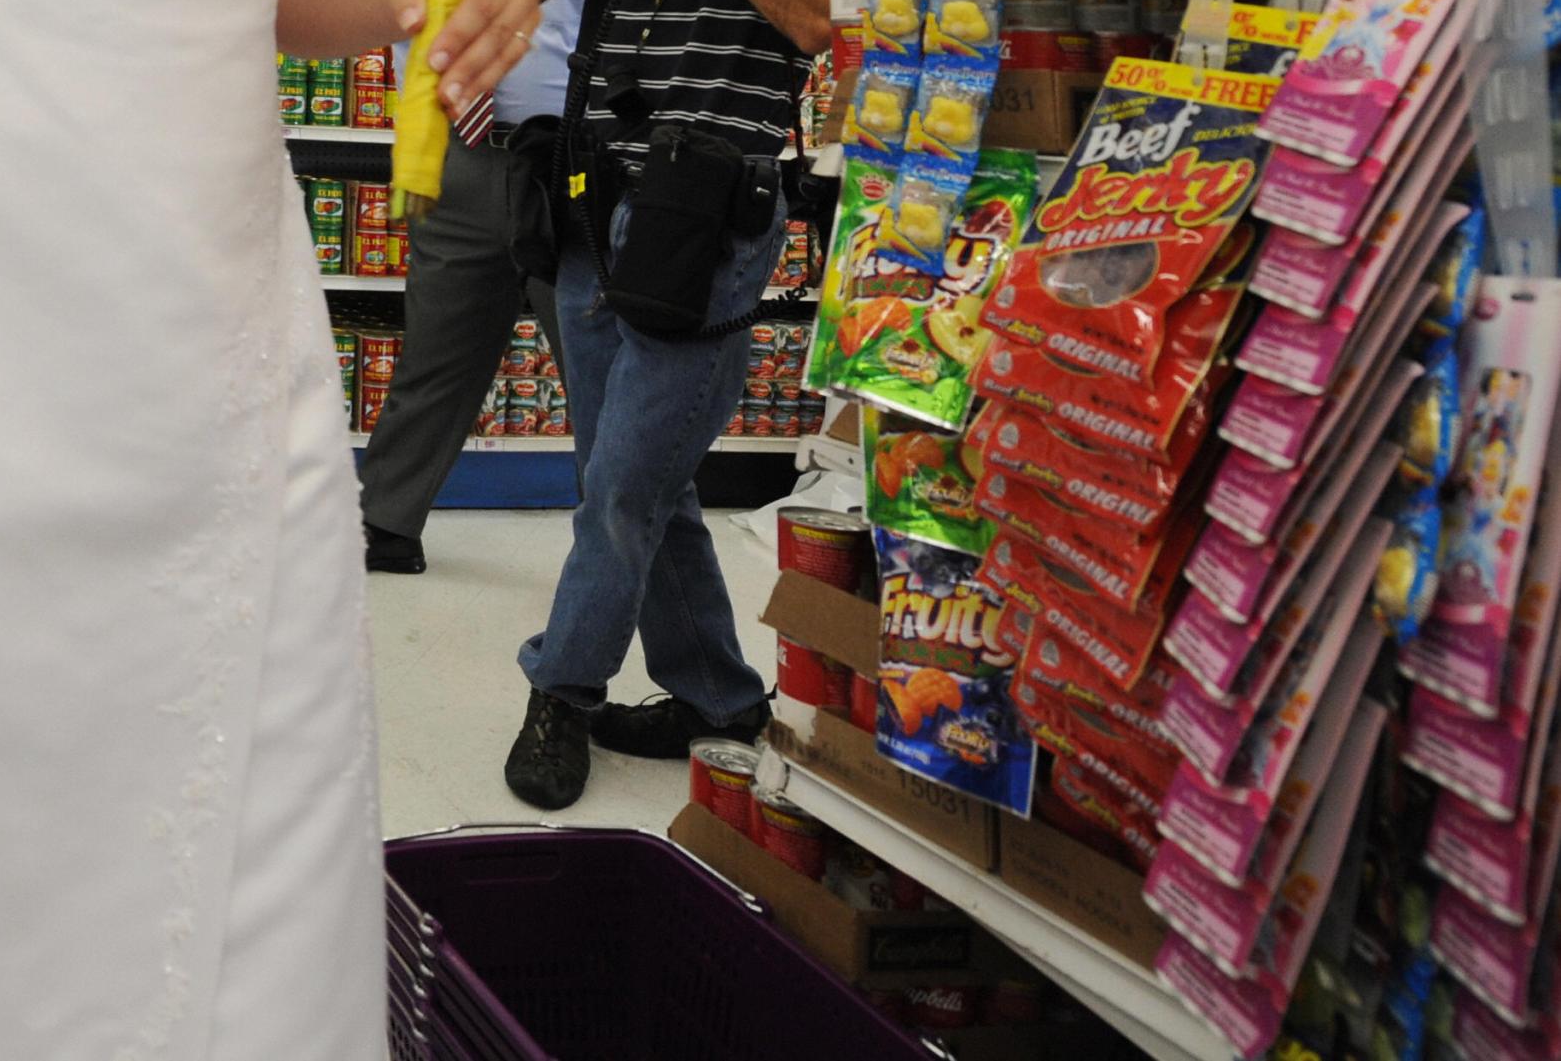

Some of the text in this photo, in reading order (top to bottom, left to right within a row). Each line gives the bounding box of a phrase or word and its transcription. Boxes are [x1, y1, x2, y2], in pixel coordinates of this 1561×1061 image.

[994, 86, 1035, 111] 031
[1199, 76, 1277, 109] FREE
[1077, 100, 1201, 166] Beef
[1039, 147, 1255, 232] Jerky
[1046, 217, 1166, 251] ORIGINAL
[1048, 333, 1142, 382] ORIGINAL
[1058, 402, 1156, 451] ORIGINAL
[1067, 478, 1158, 525] ORIGIN
[1046, 536, 1130, 599] ORIGINAL
[881, 573, 1015, 667] Fruity
[1046, 609, 1131, 679] ORIGINAL
[1110, 702, 1161, 735] ORIG
[897, 768, 974, 824] 15031
